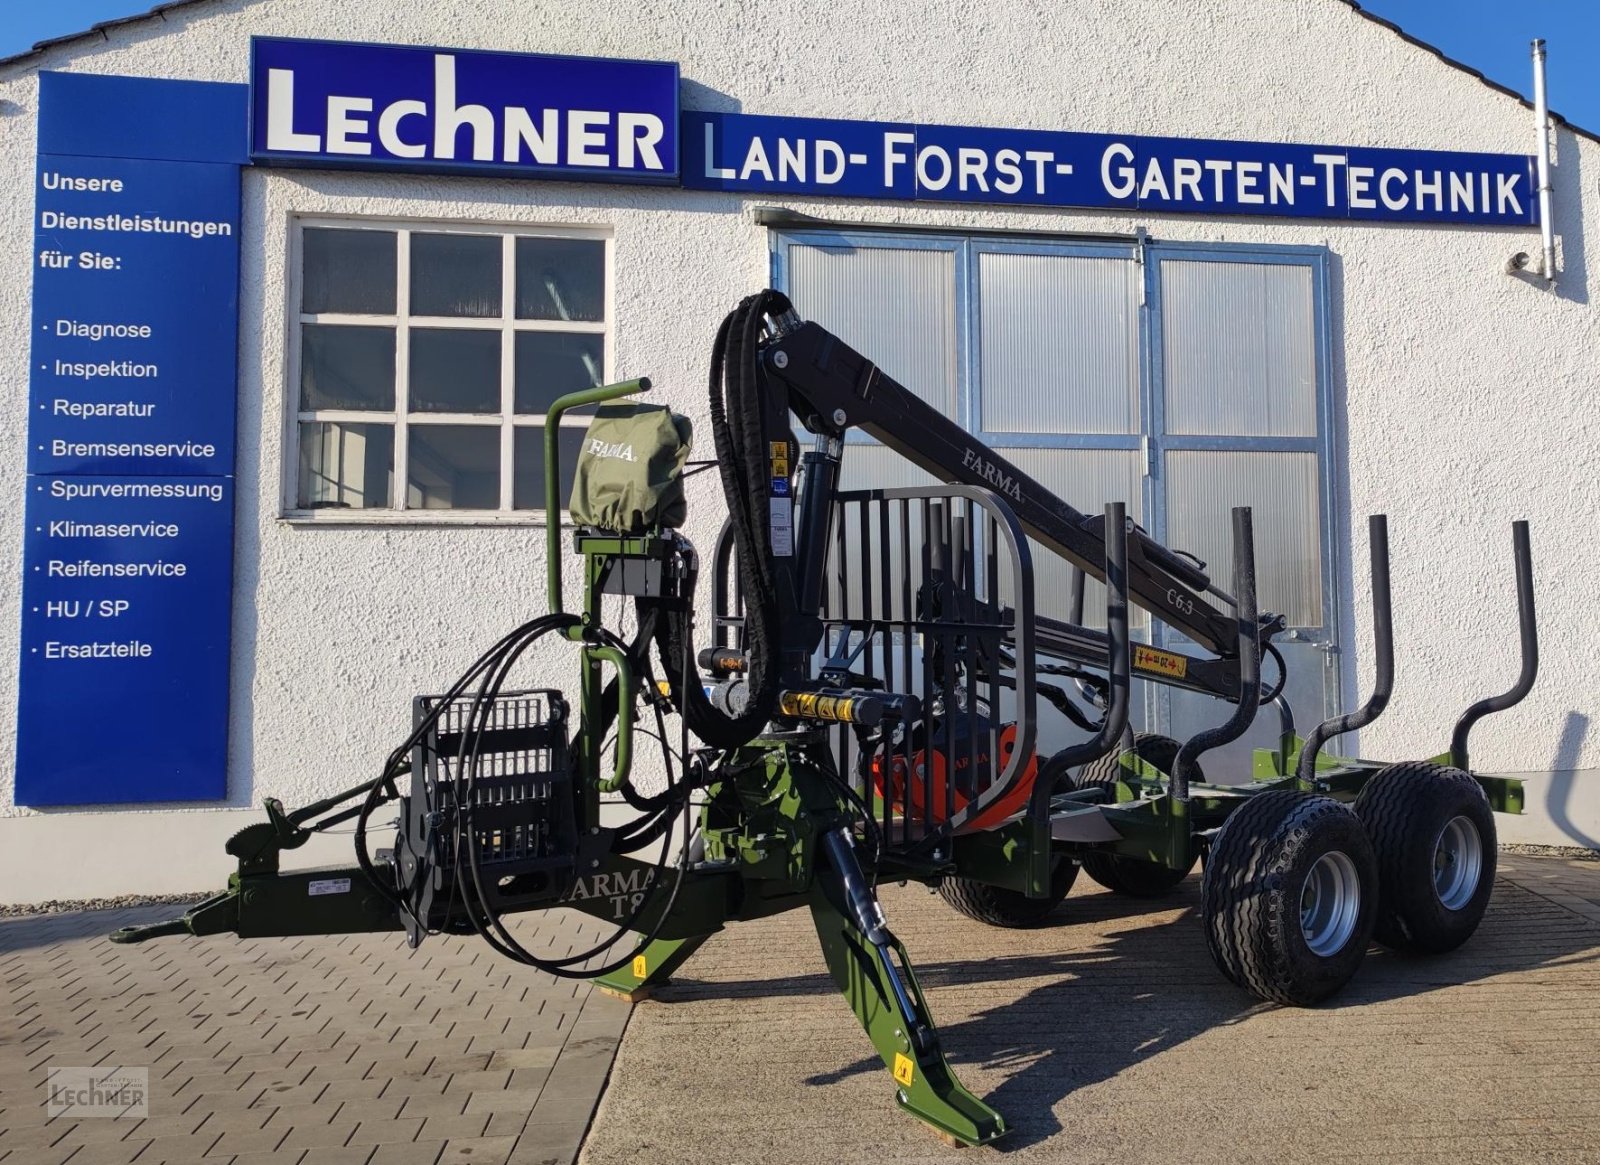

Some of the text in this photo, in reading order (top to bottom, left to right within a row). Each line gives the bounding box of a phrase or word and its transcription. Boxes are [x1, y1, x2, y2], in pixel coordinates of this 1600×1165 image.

[704, 122, 868, 185] LAND-
[883, 132, 1073, 195] FORST-
[42, 173, 124, 193] Unsere
[41, 212, 232, 238] Dienstleistungen
[40, 251, 121, 271] für Sie:
[56, 320, 152, 341] Diagnose
[55, 360, 158, 381] Inspektion
[53, 399, 156, 420] Reparatur
[52, 440, 216, 458] Bremsenservice
[961, 447, 1021, 502] FARMA
[51, 480, 223, 502] Spurvermessung
[49, 520, 179, 538] Klimaservice
[48, 559, 187, 577] Reifenservice
[47, 600, 130, 618] HU / SP
[45, 640, 153, 659] Ersatzteile
